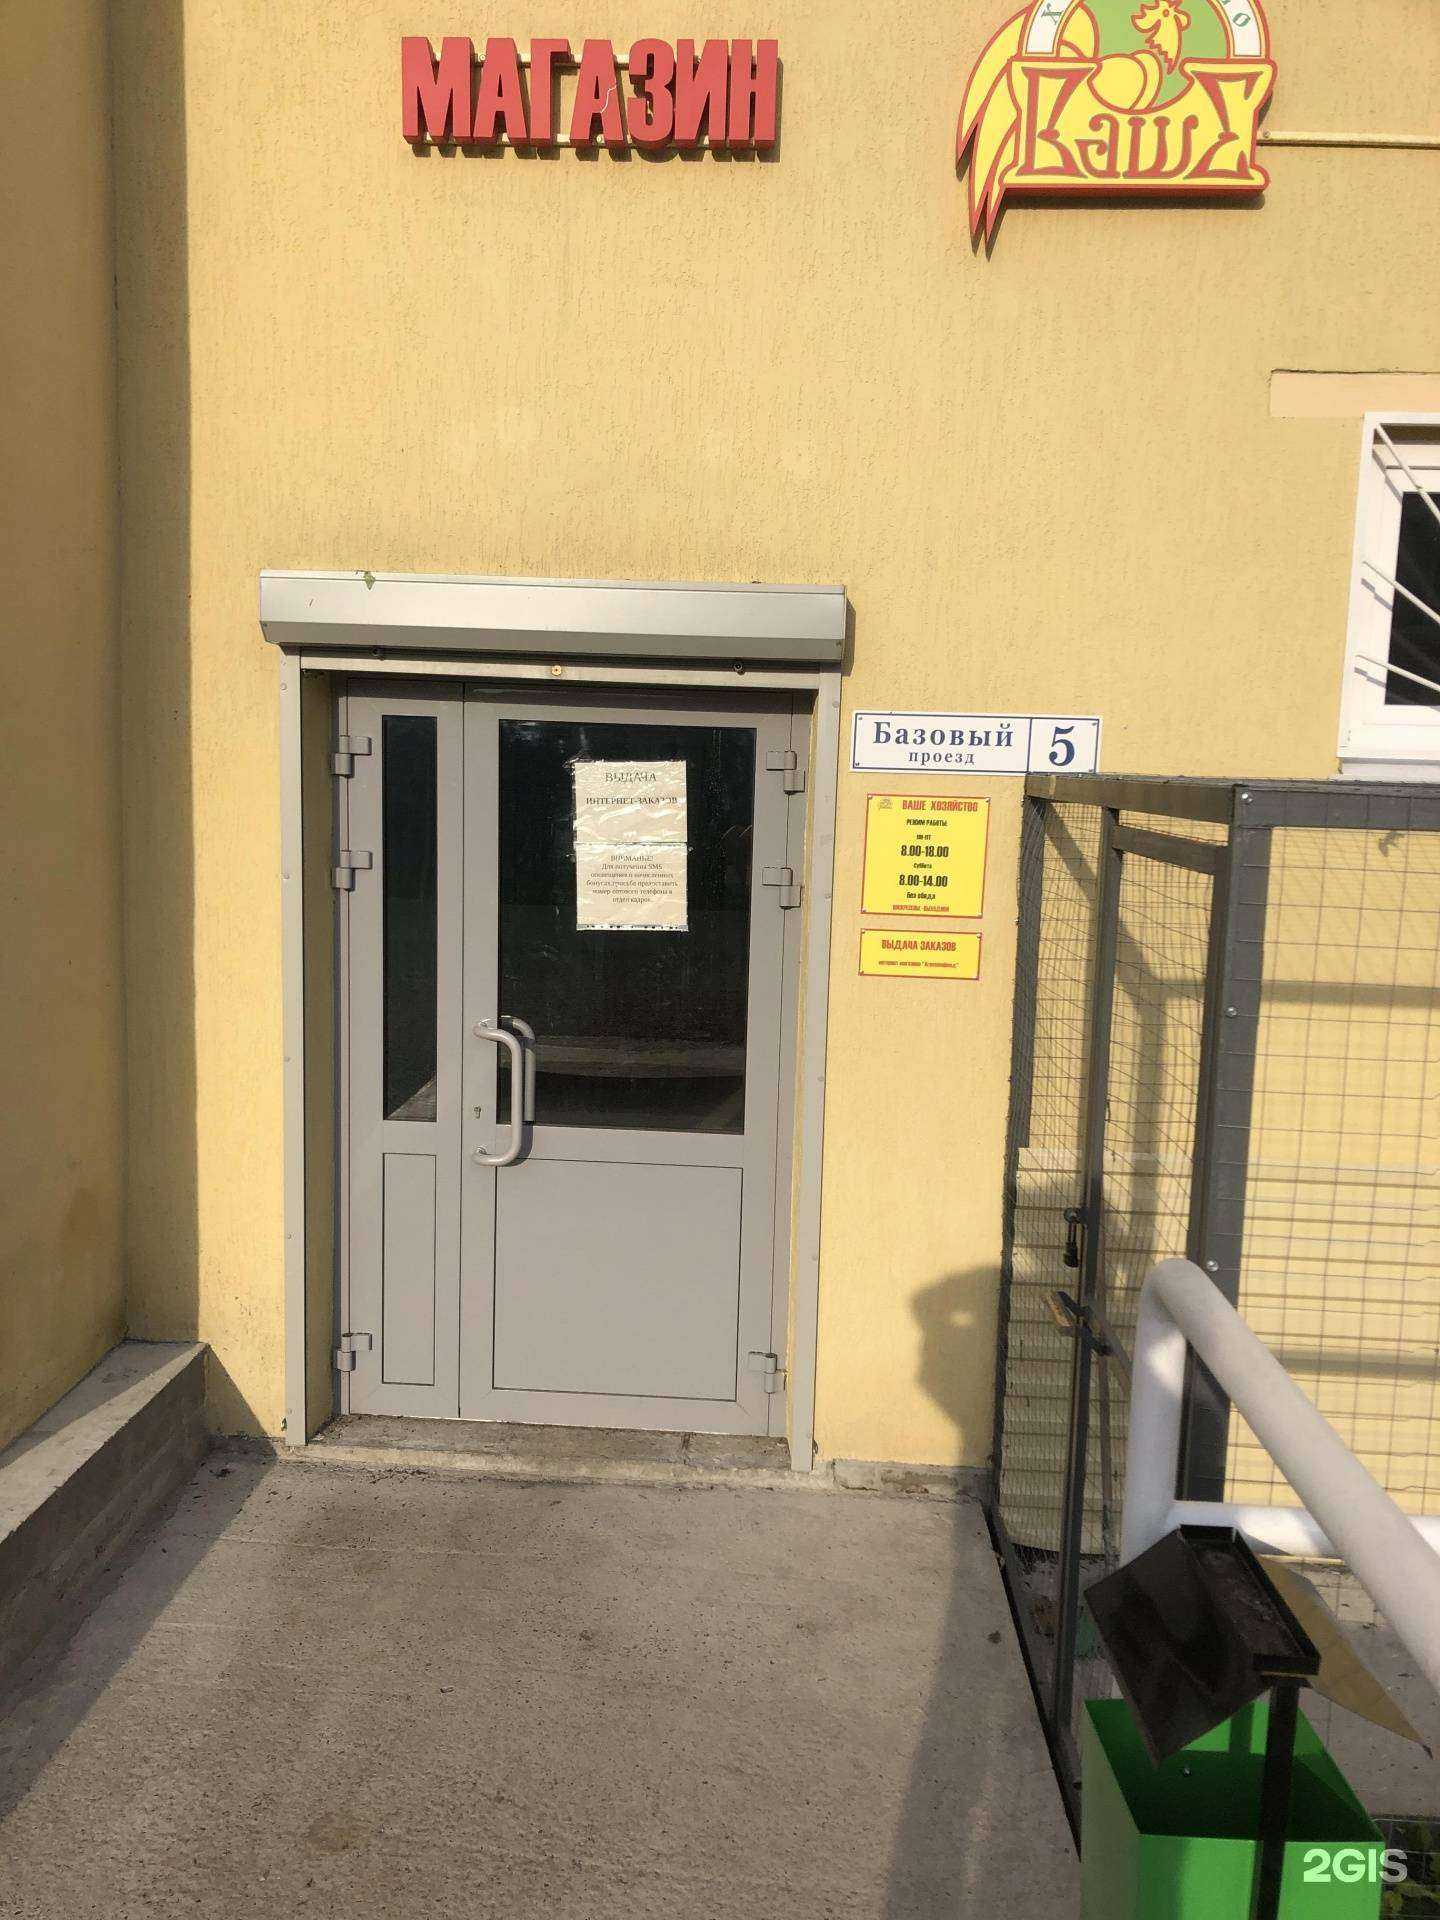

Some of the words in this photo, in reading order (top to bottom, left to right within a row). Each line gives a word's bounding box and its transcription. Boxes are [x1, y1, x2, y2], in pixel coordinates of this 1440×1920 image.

[402, 36, 779, 151] МАГАЗИН
[873, 721, 1013, 748] Базовый
[1048, 725, 1075, 766] 5
[908, 751, 975, 764] проезд
[902, 800, 926, 810] ВАШЕ
[930, 800, 978, 812] ХОЗЯЙСТВО
[900, 845, 950, 858] 8.00-18.00
[899, 874, 948, 888] 8.00-14.00
[881, 939, 919, 951] ВЫДАЧА
[920, 941, 957, 952] ЗАКАЗОВ
